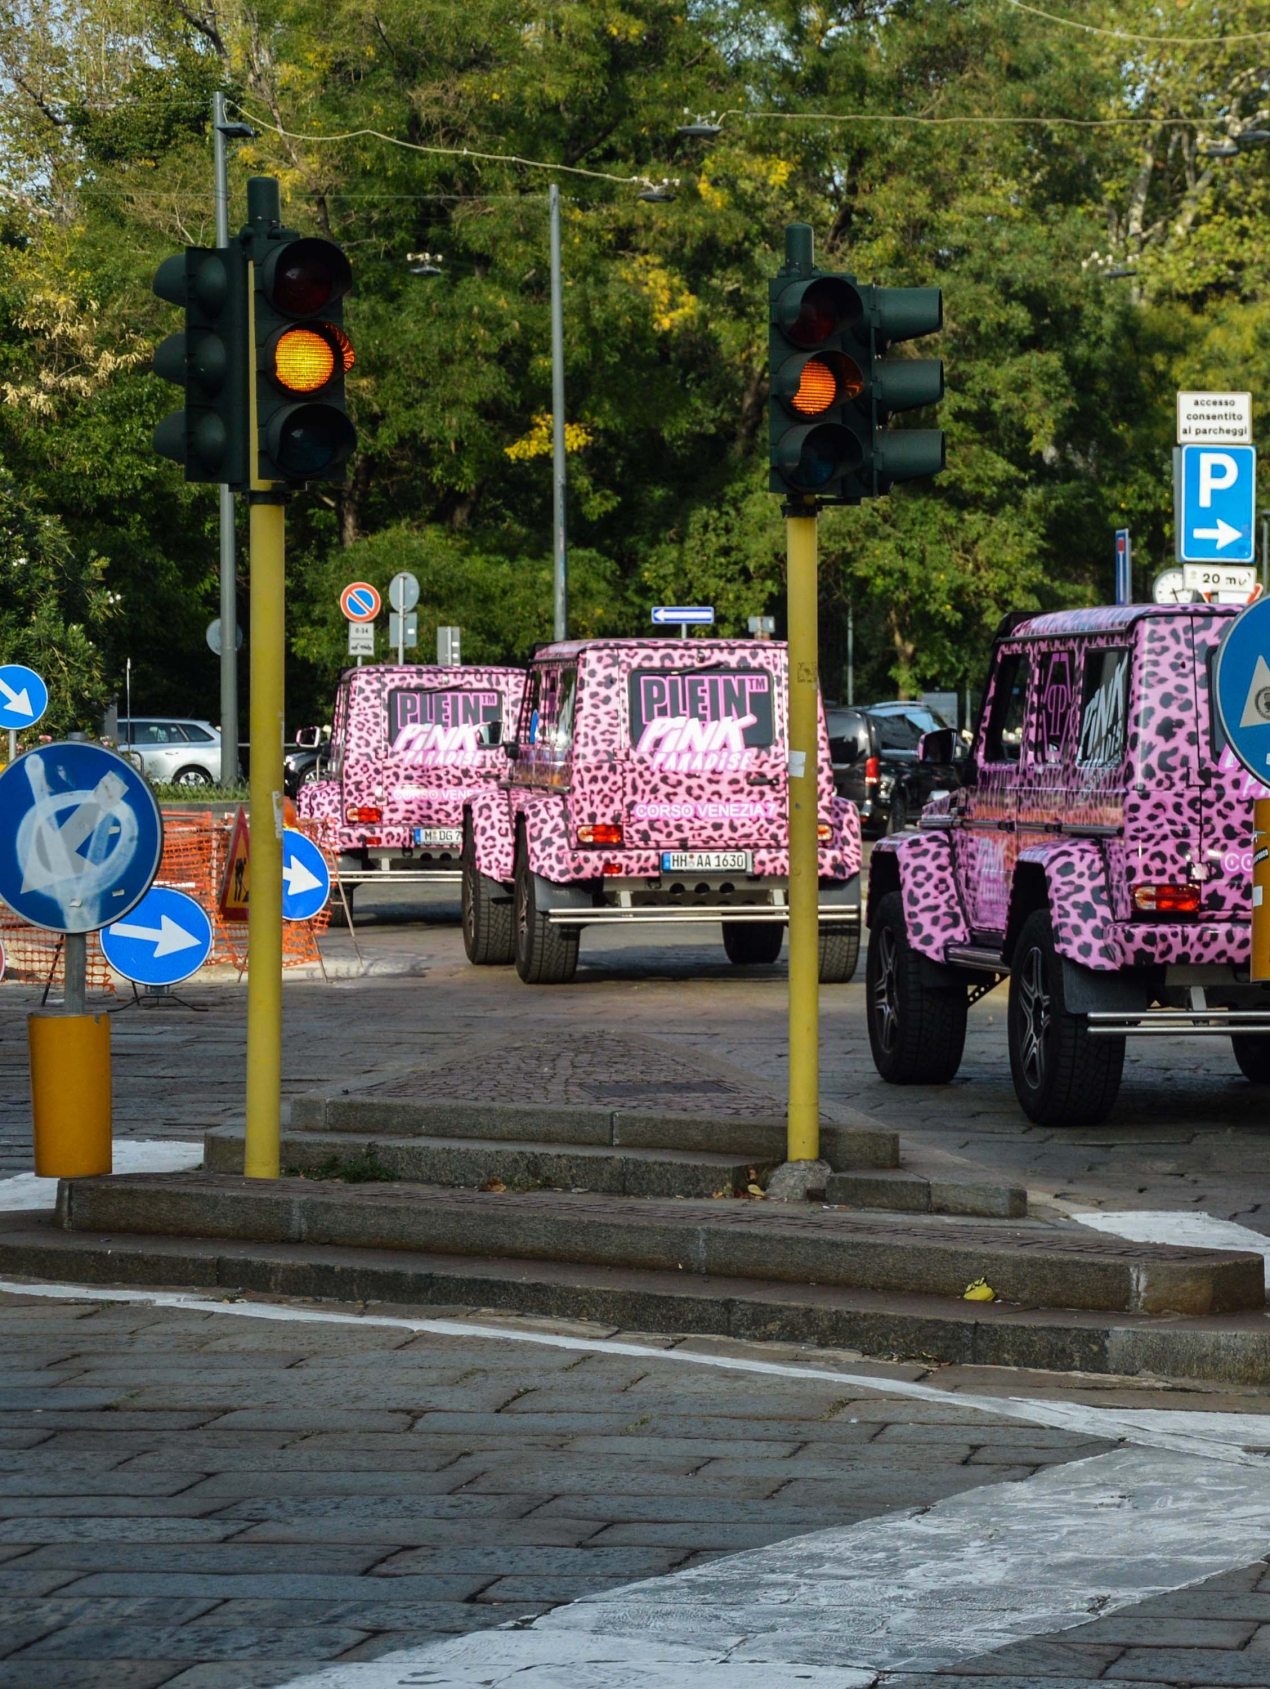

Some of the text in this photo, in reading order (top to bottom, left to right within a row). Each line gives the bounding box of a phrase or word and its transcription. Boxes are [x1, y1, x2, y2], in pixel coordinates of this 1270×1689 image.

[1193, 398, 1236, 407] accesso
[1186, 411, 1243, 421] consentito
[1194, 425, 1248, 437] parcheggi
[1198, 452, 1239, 508] P
[1202, 573, 1220, 584] 20
[393, 788, 439, 801] CORSO
[635, 803, 776, 818] CORSO VENEZIA 7
[672, 854, 744, 867] HH AA 1630
